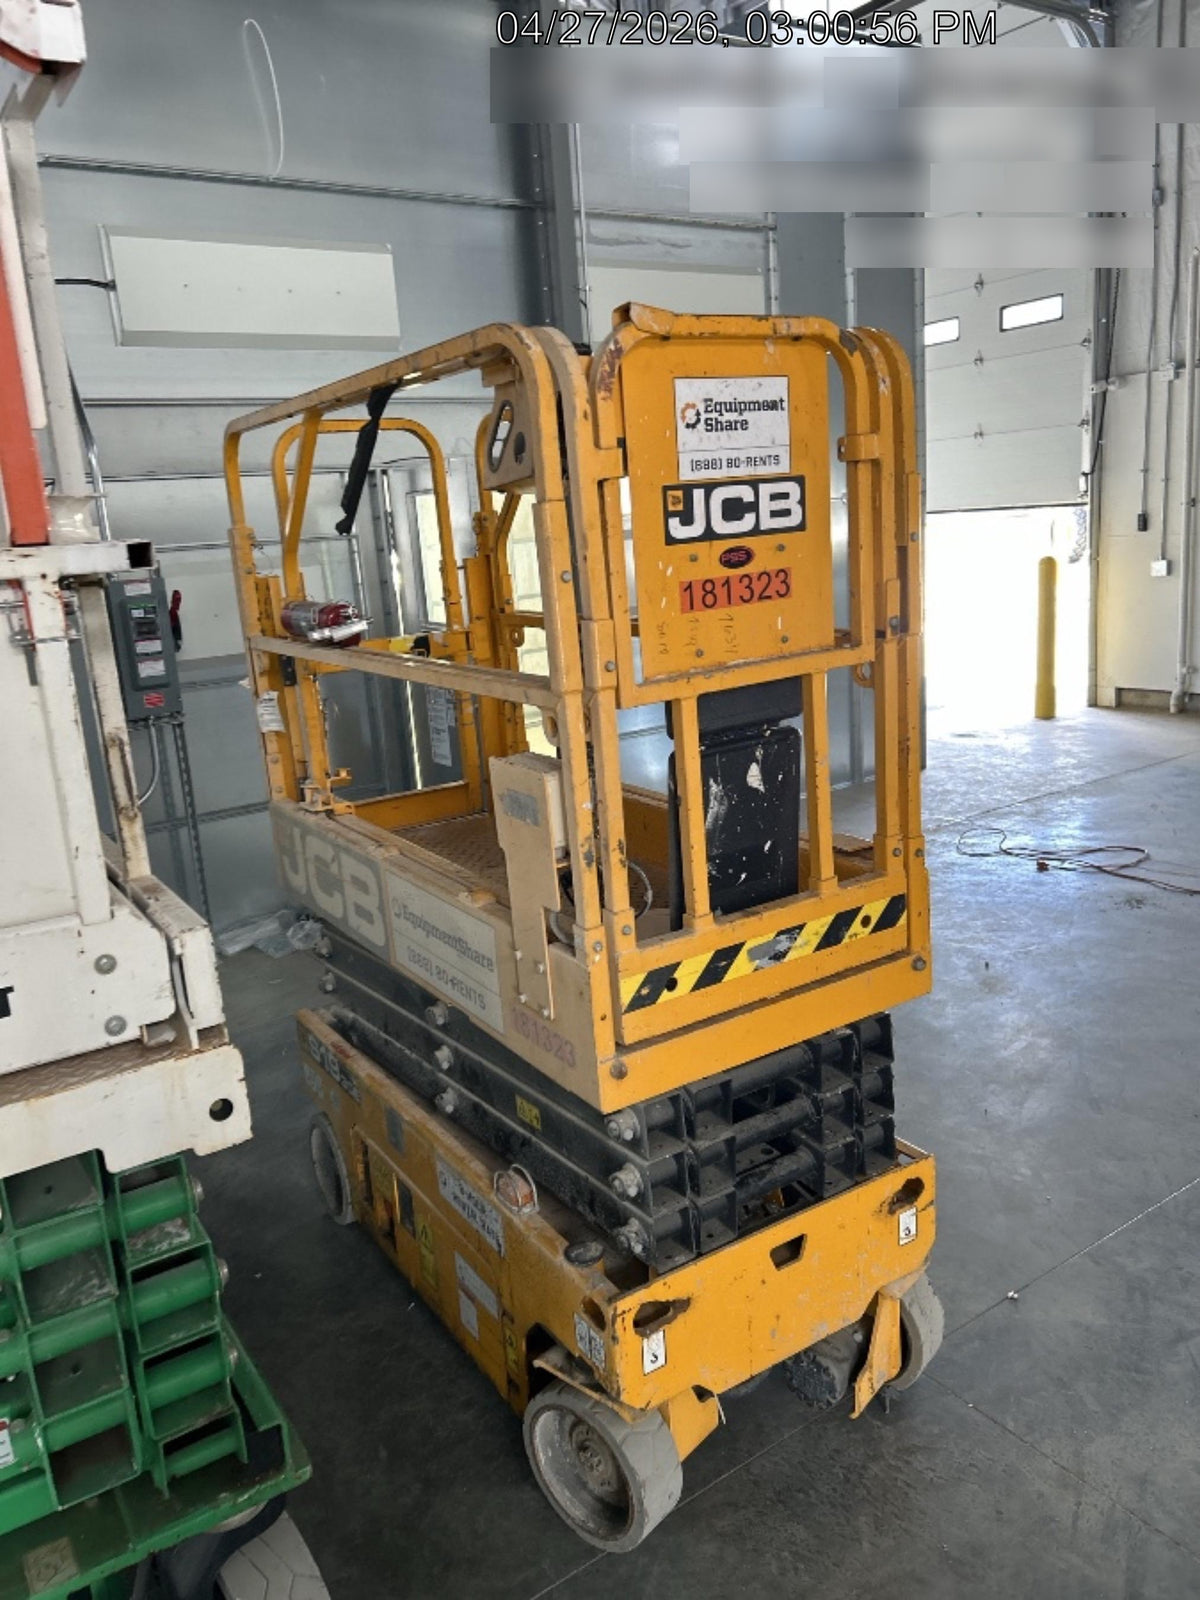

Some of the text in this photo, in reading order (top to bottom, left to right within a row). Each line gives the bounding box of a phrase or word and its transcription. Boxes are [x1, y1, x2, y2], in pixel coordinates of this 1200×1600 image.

[703, 396, 785, 417] Equipment
[704, 417, 749, 432] Share
[668, 481, 803, 540] JCB
[683, 568, 790, 611] 181323
[282, 826, 385, 946] JCB
